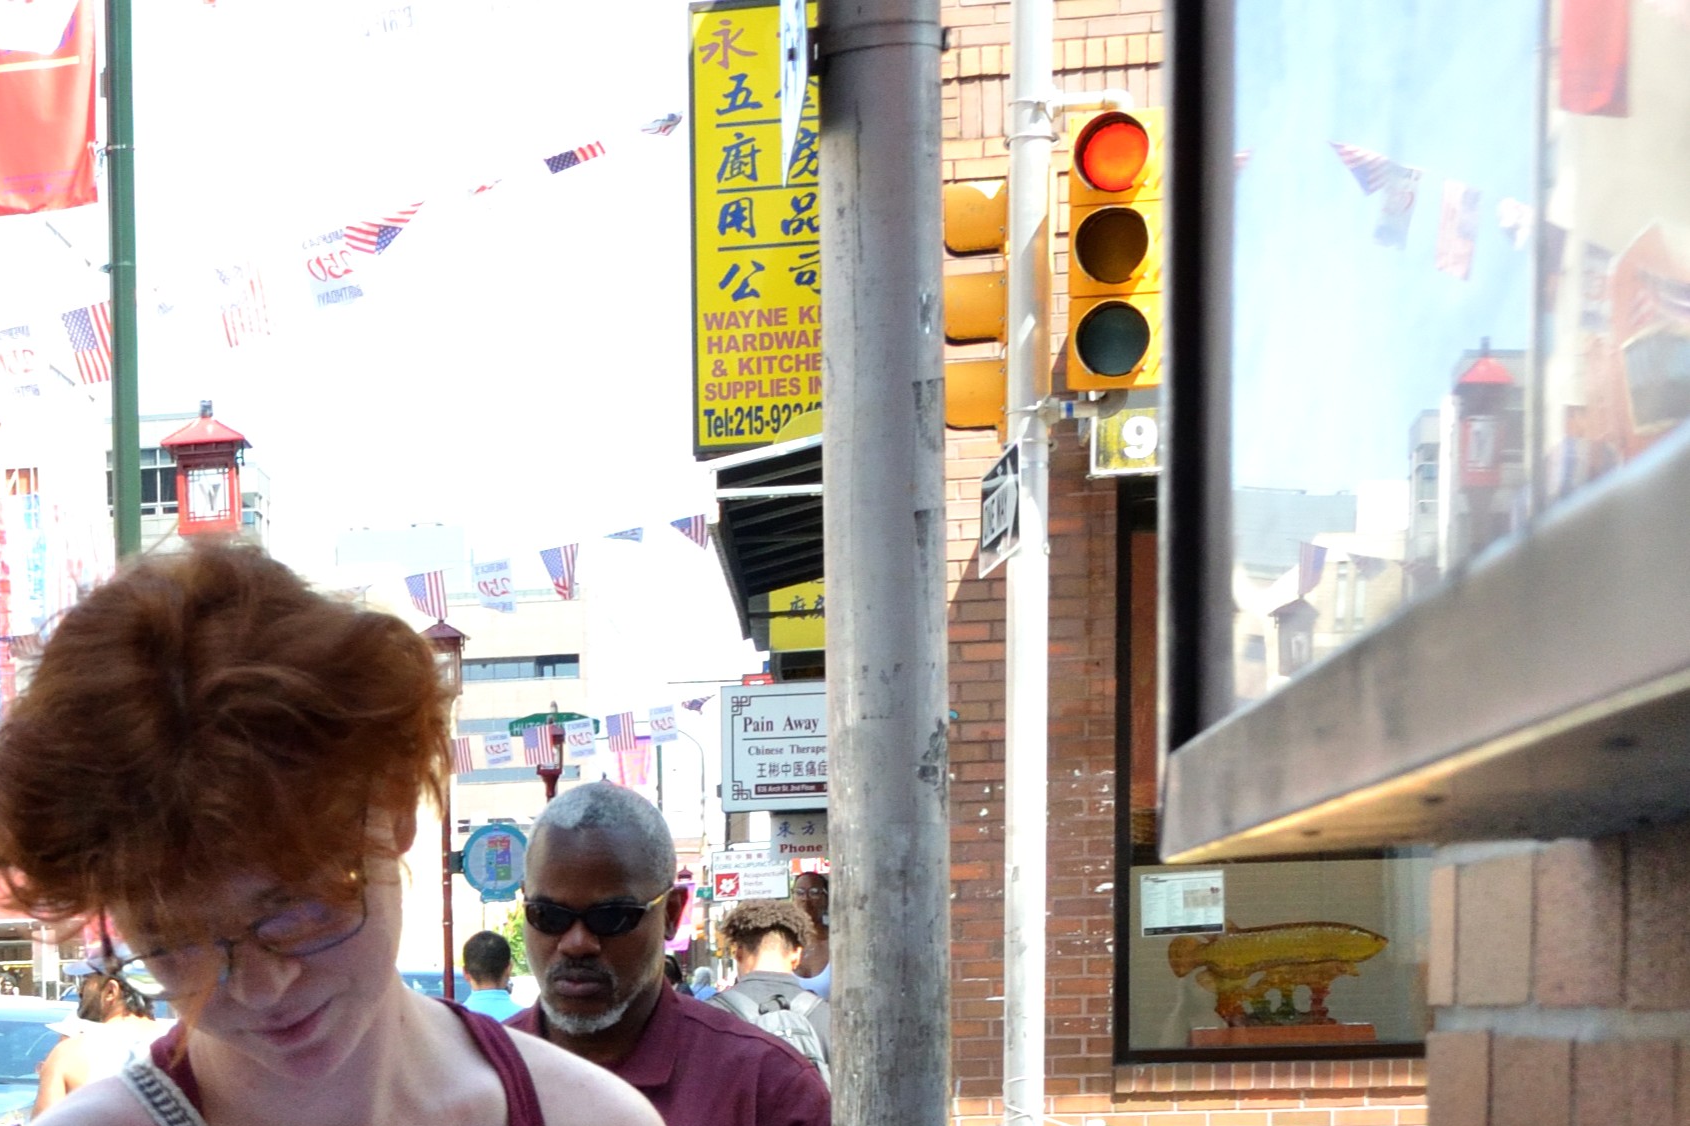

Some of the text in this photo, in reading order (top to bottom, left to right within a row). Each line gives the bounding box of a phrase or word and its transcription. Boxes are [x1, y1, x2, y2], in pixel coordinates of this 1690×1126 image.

[718, 192, 819, 238] 用品
[719, 250, 821, 301] 公司
[703, 307, 788, 331] WAYNE
[711, 353, 821, 378] & KITCHE
[704, 377, 801, 401] SUPPLIES
[1121, 416, 1159, 459] 9
[743, 715, 820, 733] Pain Away
[747, 745, 784, 756] Chinese
[780, 844, 823, 853] Phone
